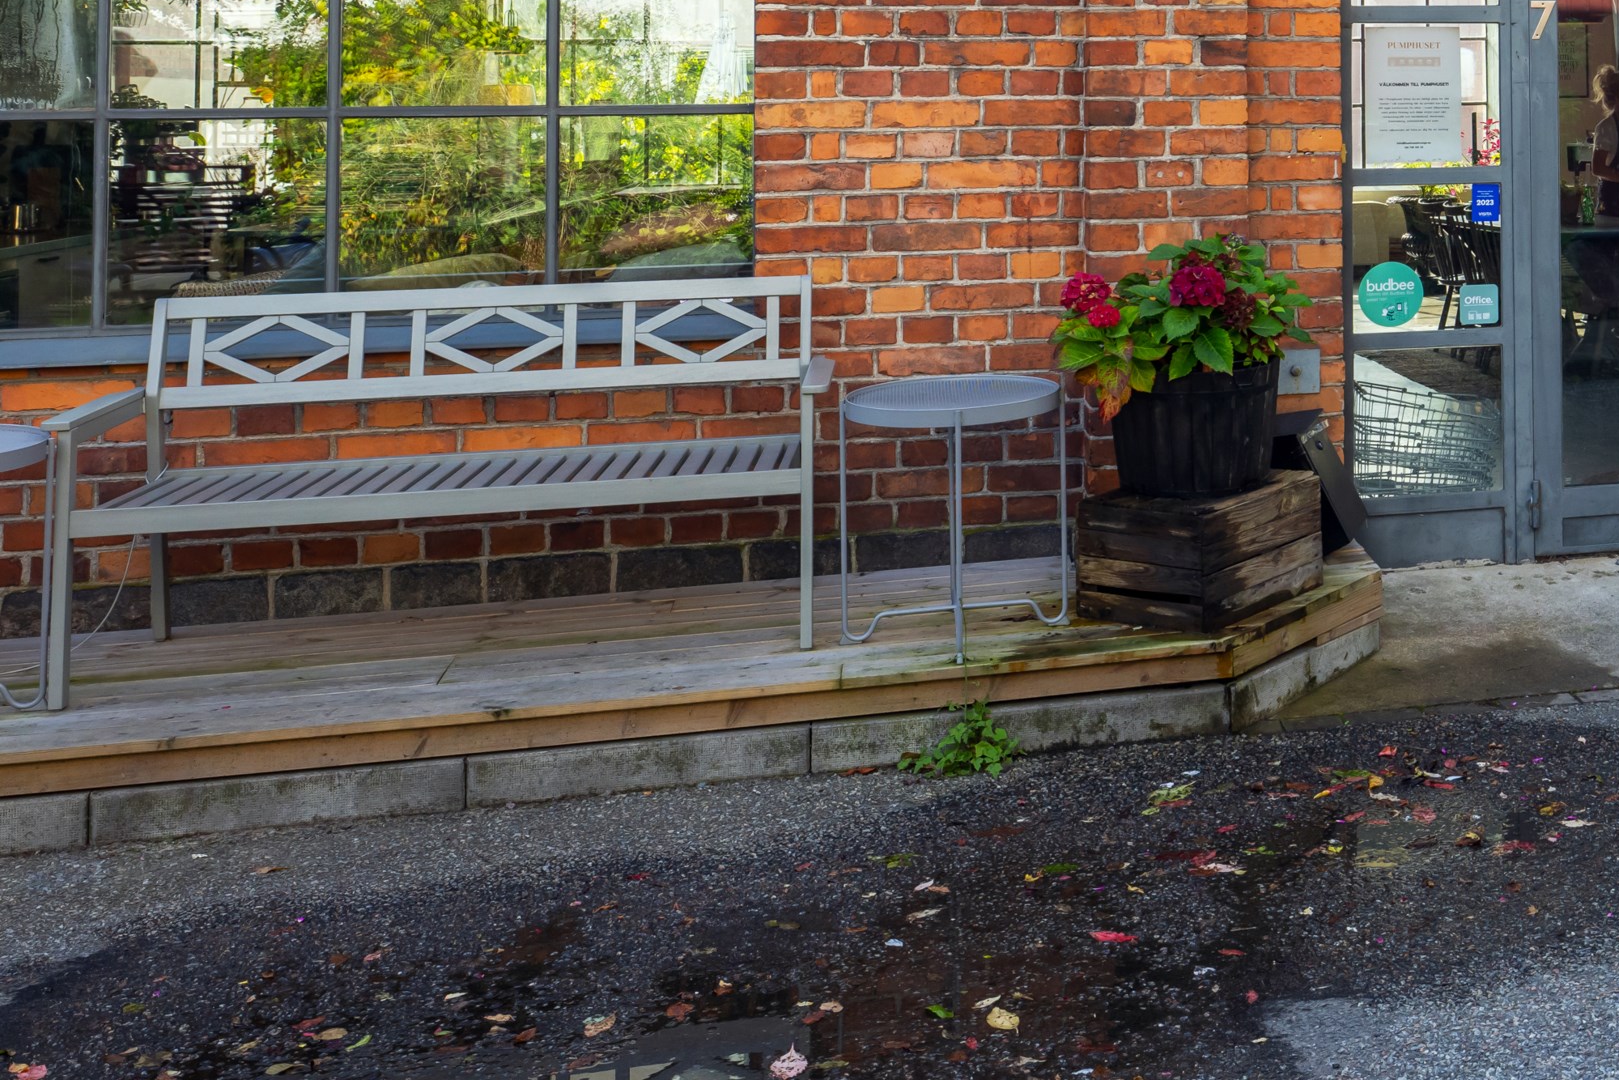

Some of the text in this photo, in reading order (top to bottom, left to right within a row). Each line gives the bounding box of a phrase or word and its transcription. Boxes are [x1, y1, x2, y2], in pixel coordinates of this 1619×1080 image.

[1530, 0, 1557, 40] 7
[1366, 278, 1415, 292] budbee
[1464, 295, 1494, 305] Office.
